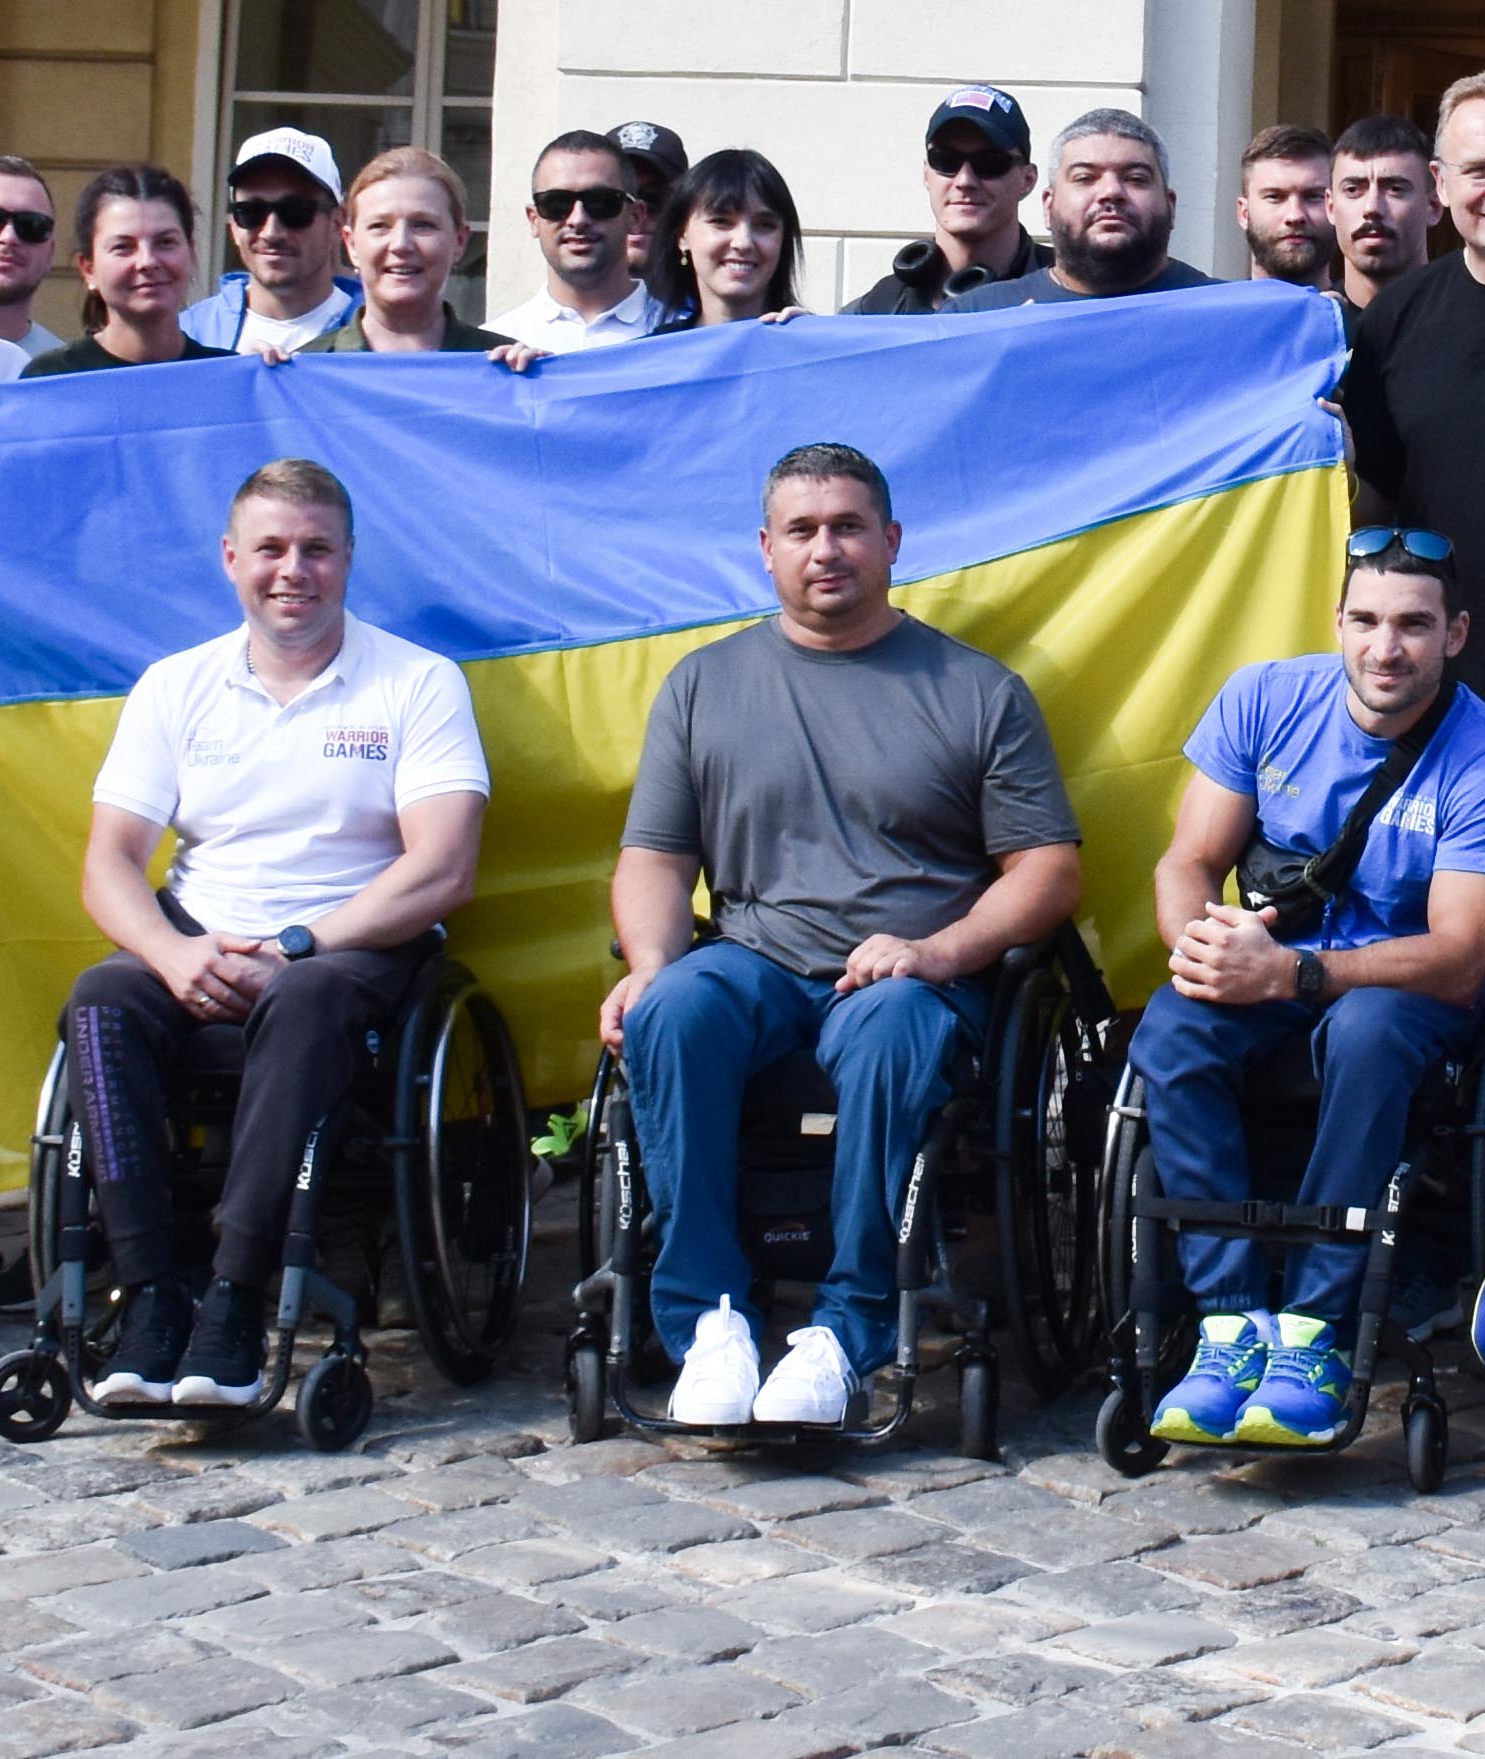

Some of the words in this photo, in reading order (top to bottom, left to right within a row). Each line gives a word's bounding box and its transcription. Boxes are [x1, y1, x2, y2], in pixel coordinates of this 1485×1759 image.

[325, 730, 389, 744] WARRIOR
[323, 742, 389, 761] GAMES
[1389, 796, 1435, 816] WARRIO
[764, 1230, 811, 1243] QUICKIE
